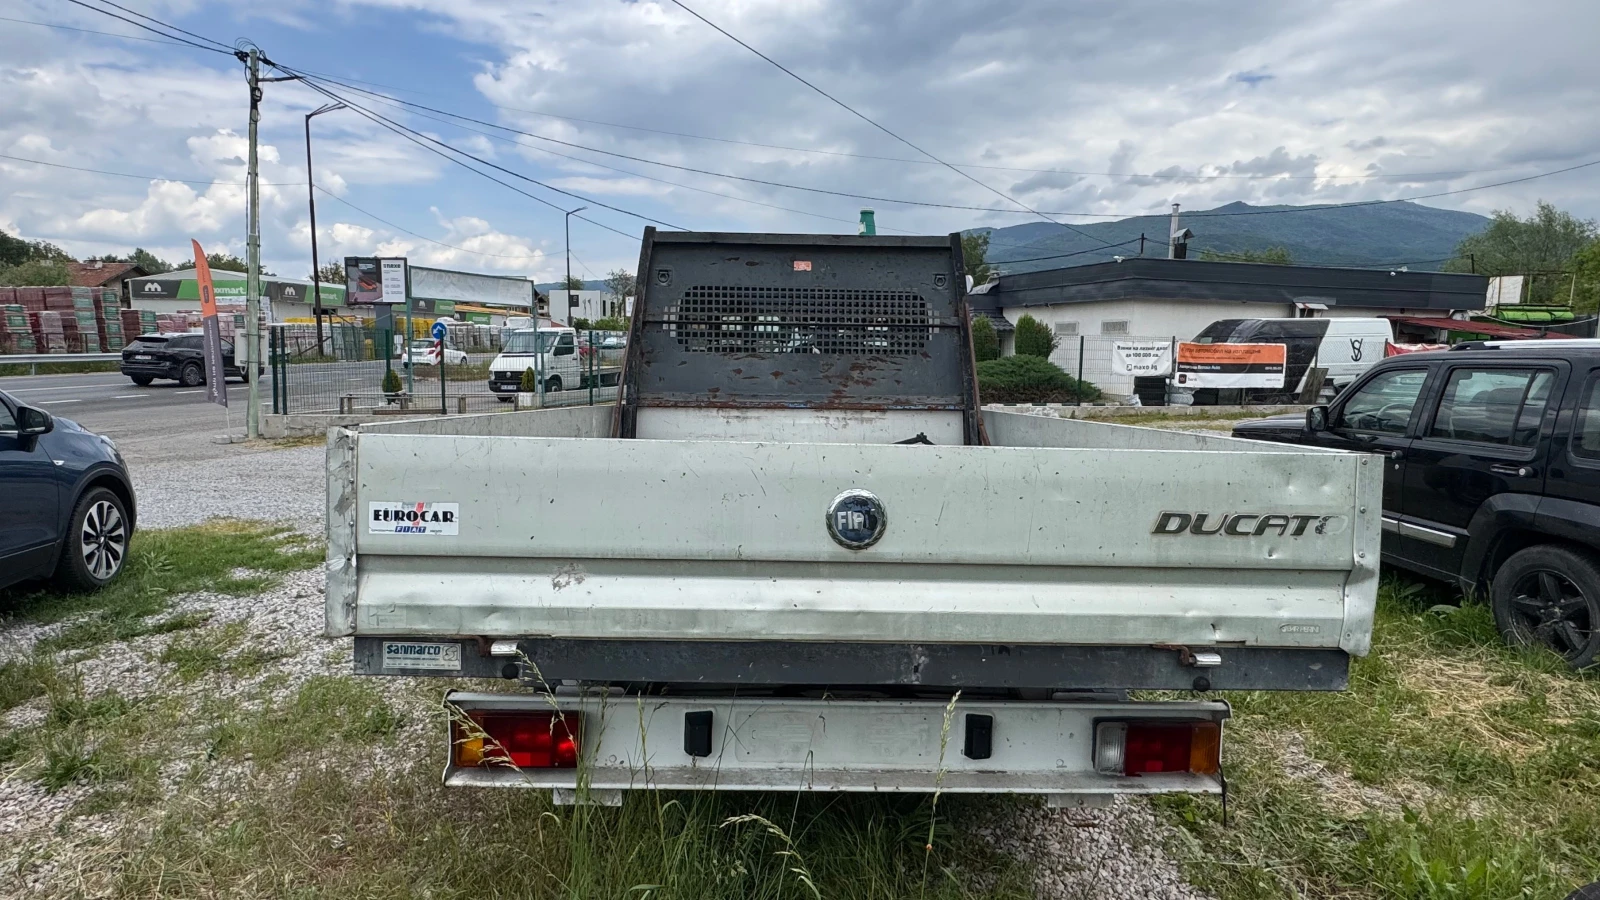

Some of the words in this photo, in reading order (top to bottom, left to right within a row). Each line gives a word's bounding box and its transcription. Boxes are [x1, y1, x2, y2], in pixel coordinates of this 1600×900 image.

[373, 508, 454, 523] EUROCAR
[837, 510, 870, 531] FIA
[1152, 511, 1349, 536] DUCATO
[386, 644, 441, 655] sanmarco
